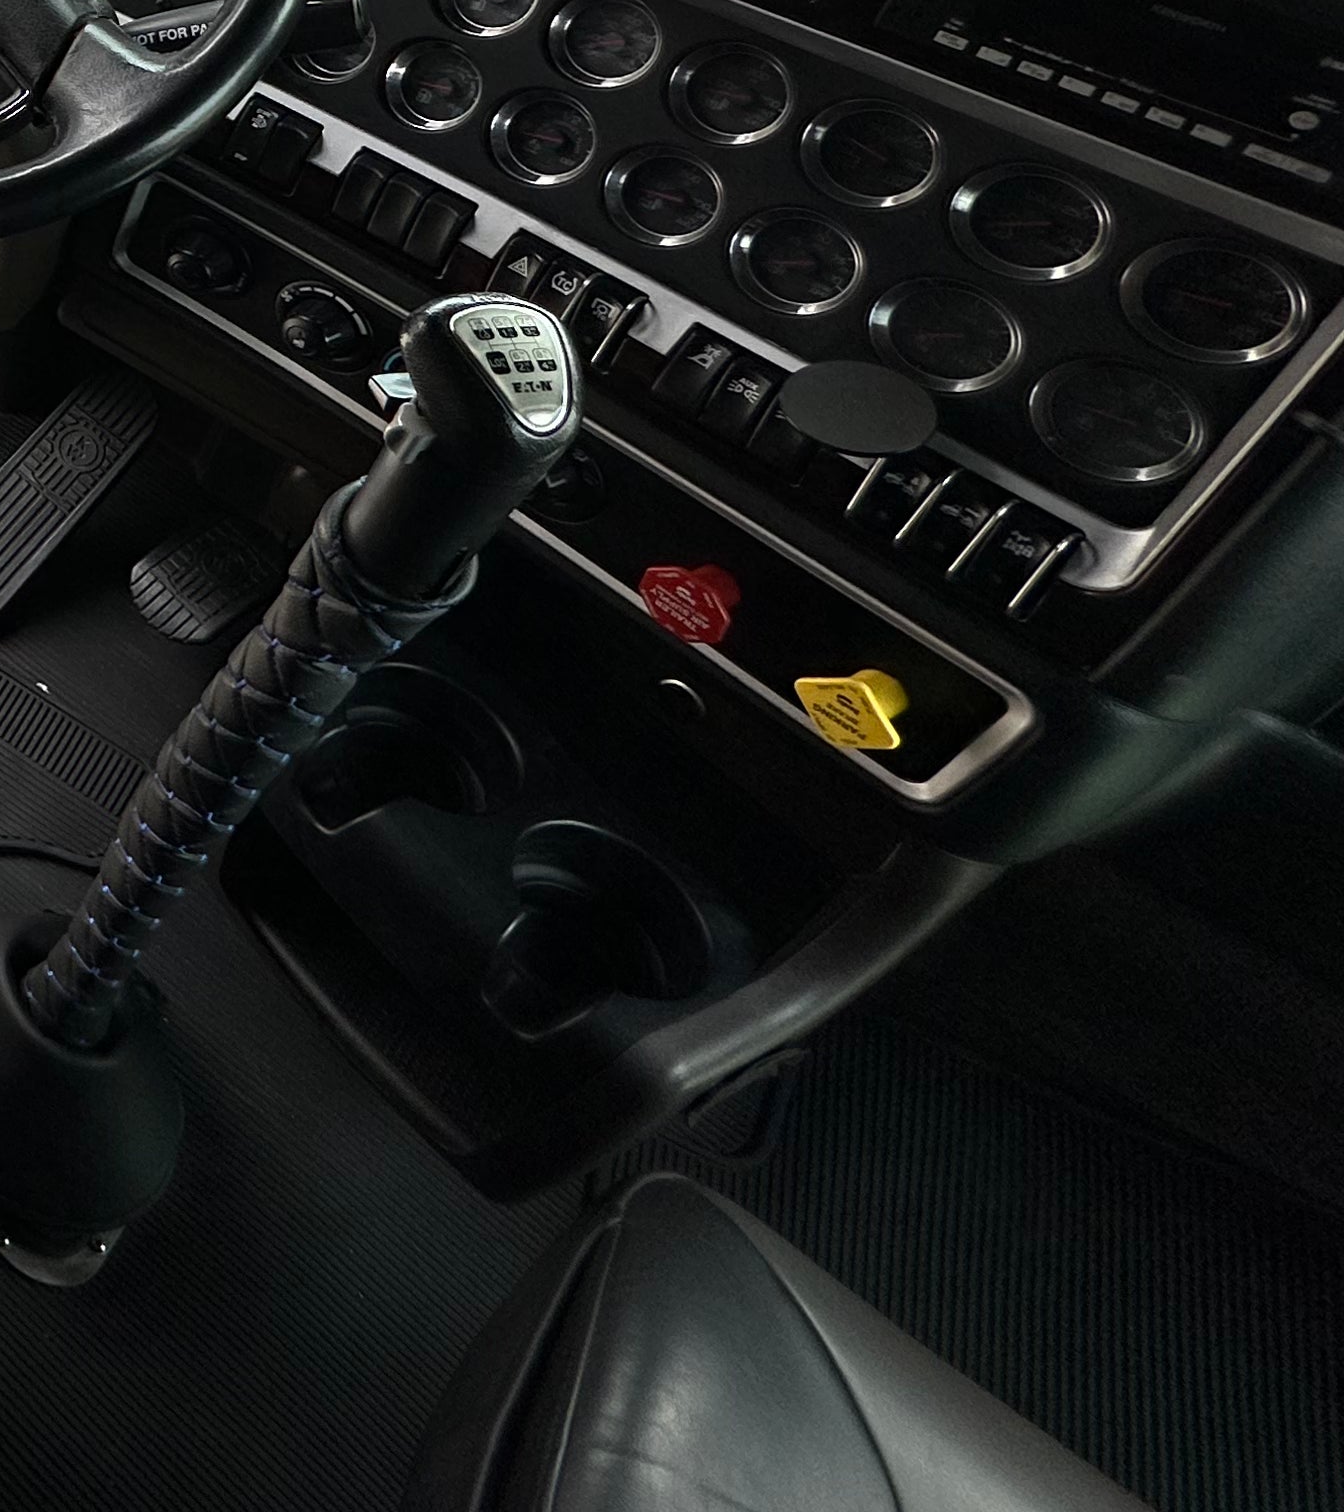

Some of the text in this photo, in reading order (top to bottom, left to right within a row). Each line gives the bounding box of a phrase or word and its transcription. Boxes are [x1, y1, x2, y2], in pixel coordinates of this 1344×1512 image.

[158, 26, 188, 42] FOR
[557, 276, 573, 291] TC
[738, 377, 760, 391] AUX
[654, 598, 698, 633] TRAILER
[689, 614, 711, 629] AIR
[812, 702, 867, 741] PARKING
